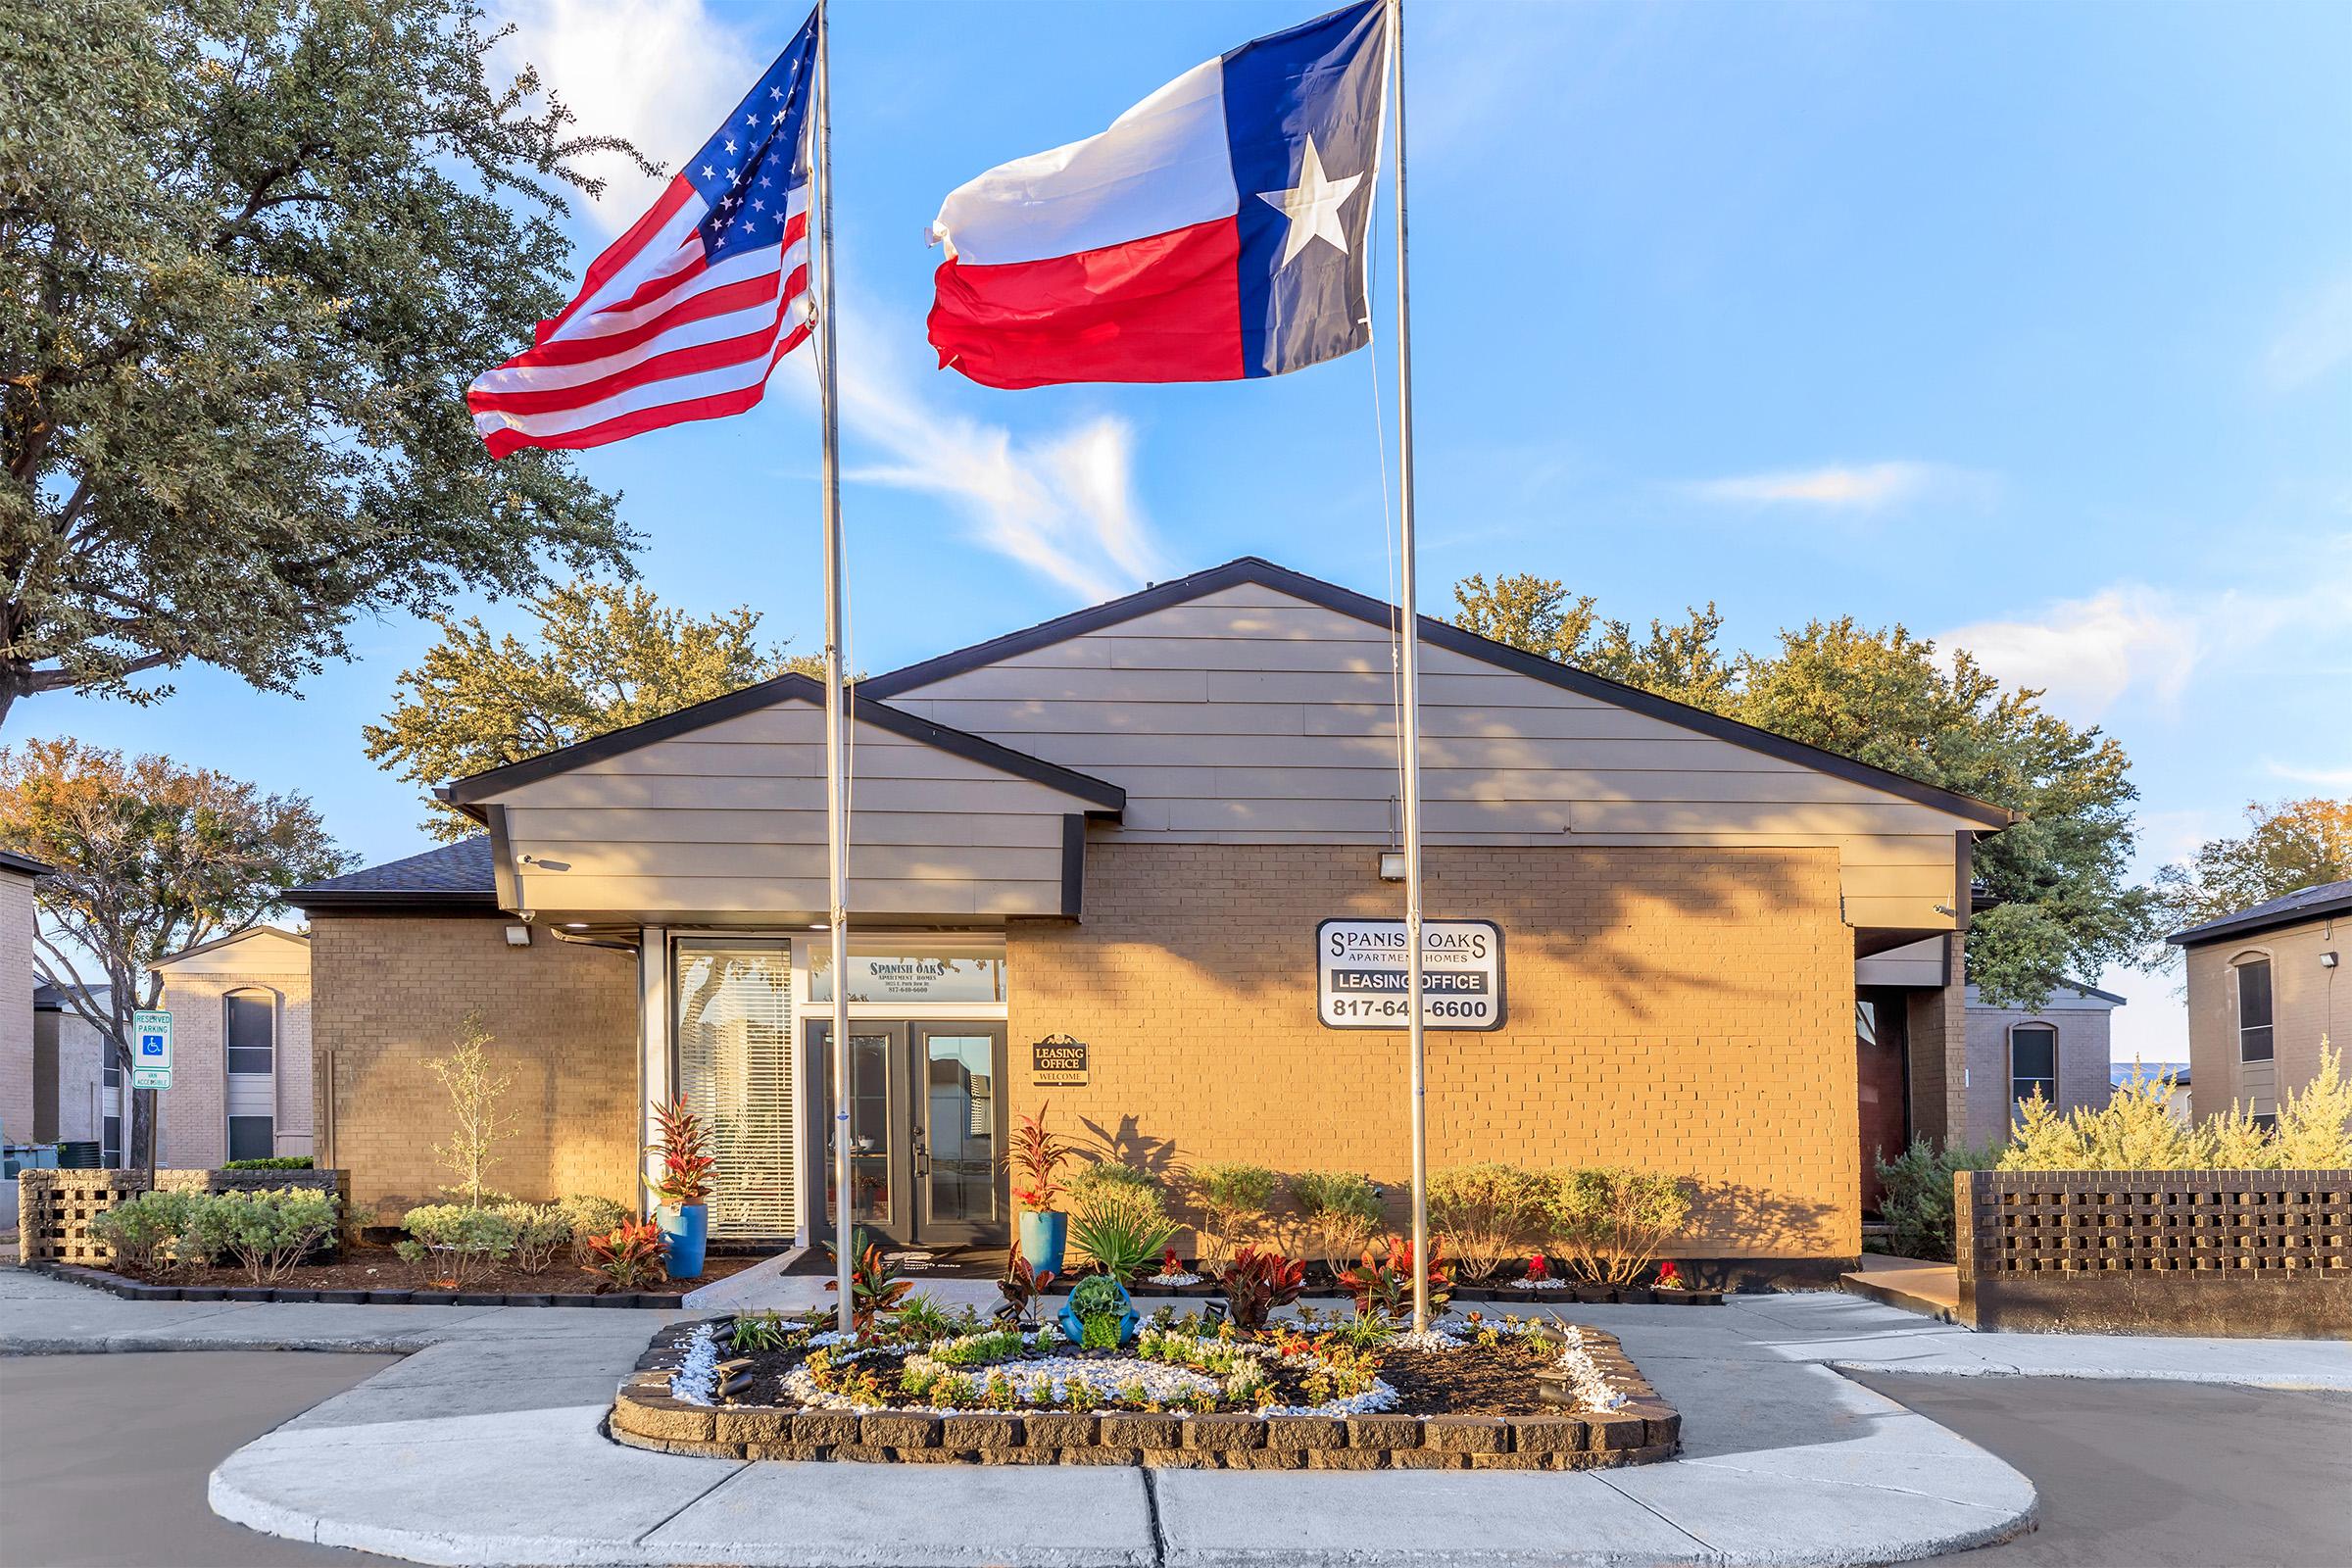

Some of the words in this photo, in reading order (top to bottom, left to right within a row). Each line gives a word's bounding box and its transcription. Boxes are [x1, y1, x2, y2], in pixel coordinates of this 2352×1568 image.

[1331, 932, 1405, 956] SPANIS
[1428, 934, 1486, 958] OAKS
[1348, 953, 1409, 962] APARTME
[1425, 954, 1468, 963] HOMES
[870, 962, 912, 975] SPANISH
[916, 962, 945, 976] OAKS
[1339, 973, 1409, 989] LEASING
[1422, 975, 1481, 990] OFFICE
[1333, 1000, 1487, 1018] 817-64-6600
[1036, 1049, 1084, 1058] LEASING
[1041, 1058, 1079, 1068] OFFICE
